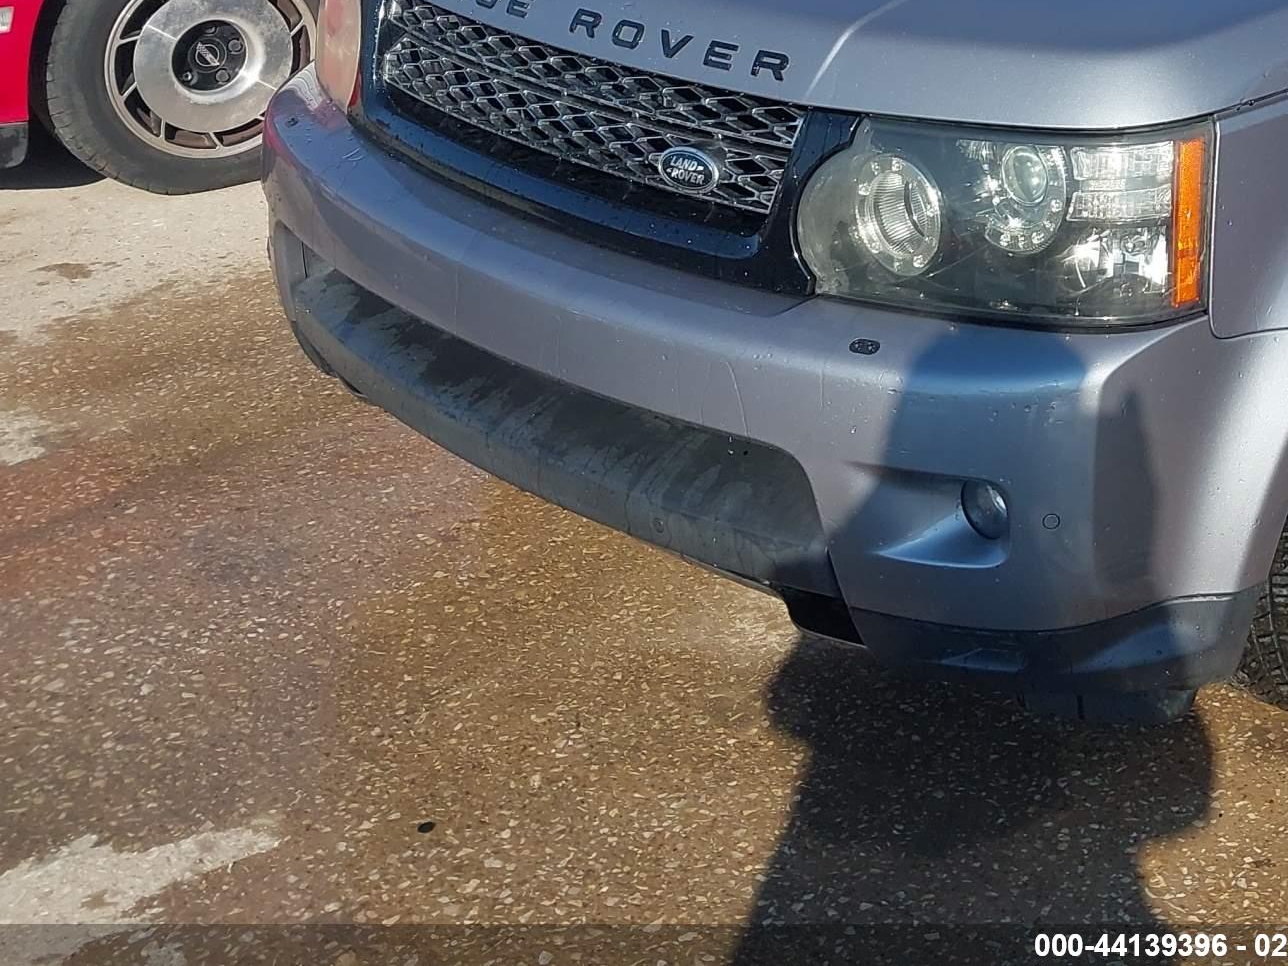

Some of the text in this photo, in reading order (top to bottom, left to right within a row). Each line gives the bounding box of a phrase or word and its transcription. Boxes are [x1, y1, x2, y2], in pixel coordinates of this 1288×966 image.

[568, 8, 790, 82] ROVER
[670, 156, 698, 171] LAND
[671, 167, 705, 185] ROVER
